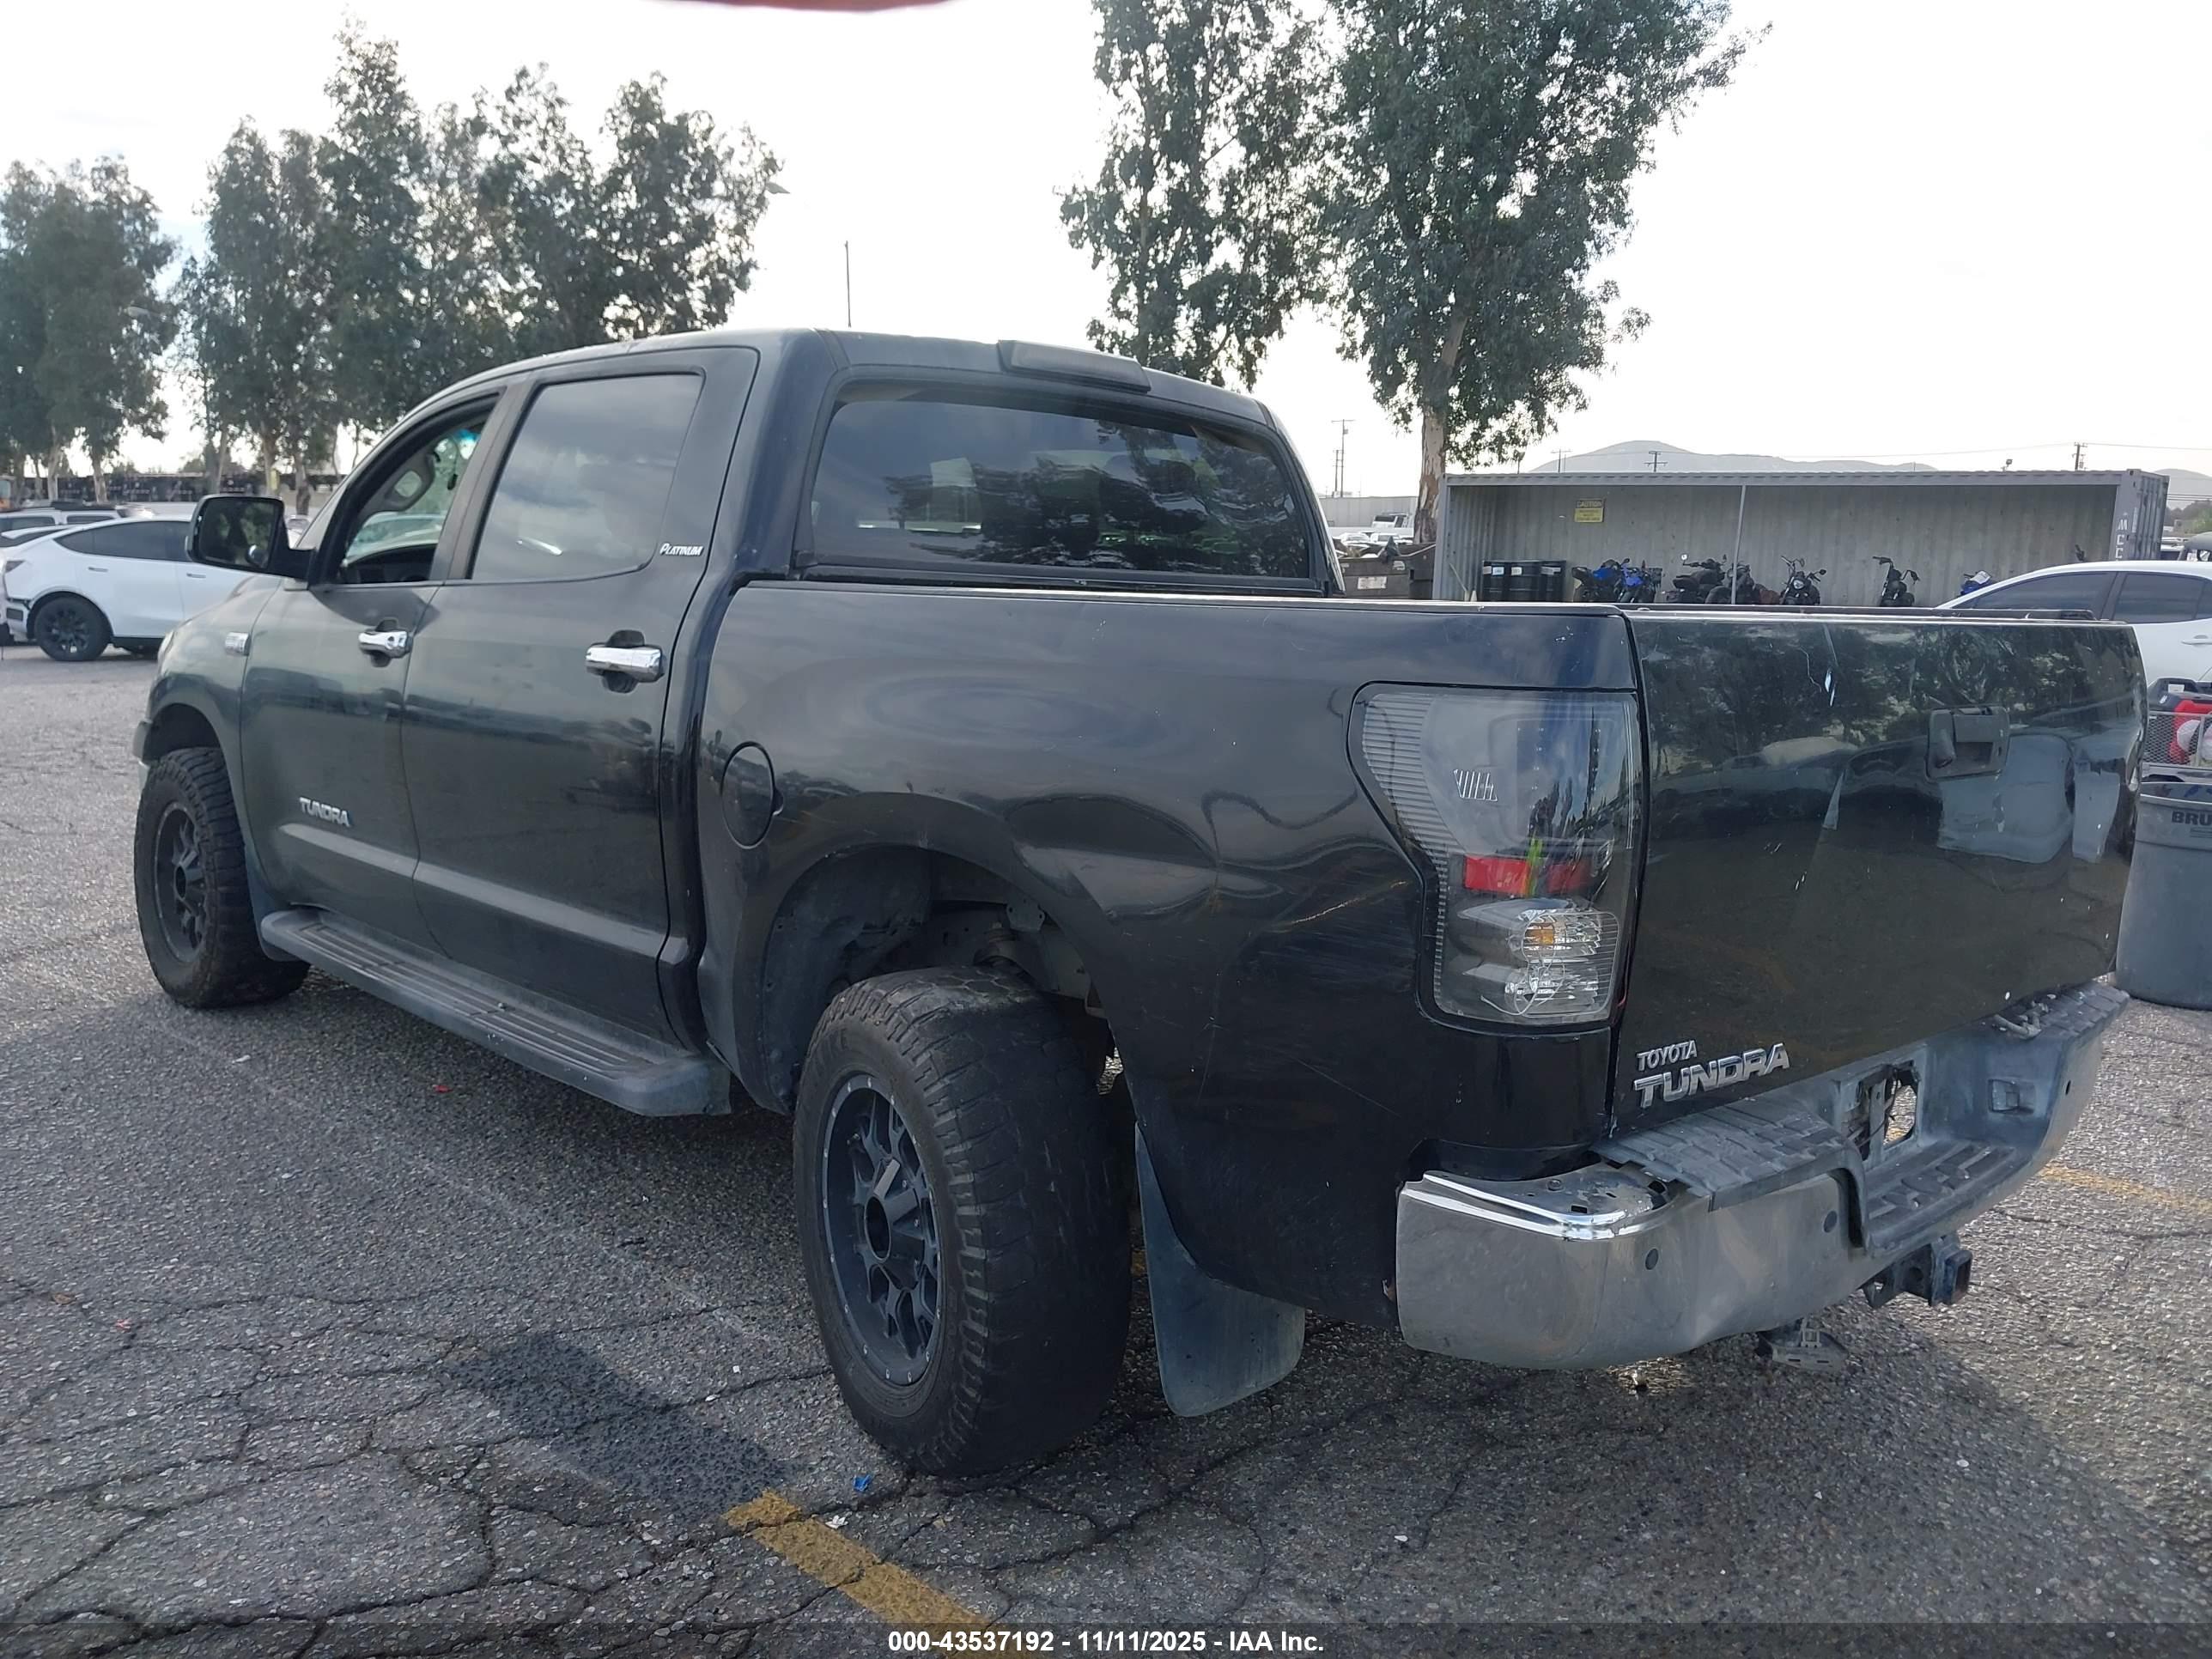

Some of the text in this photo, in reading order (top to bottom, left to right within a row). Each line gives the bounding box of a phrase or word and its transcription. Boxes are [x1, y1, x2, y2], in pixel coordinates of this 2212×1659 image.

[299, 796, 350, 827] TUNDRA
[1637, 1040, 1698, 1072] TOYOTA
[1633, 1042, 1790, 1109] TUNDRA
